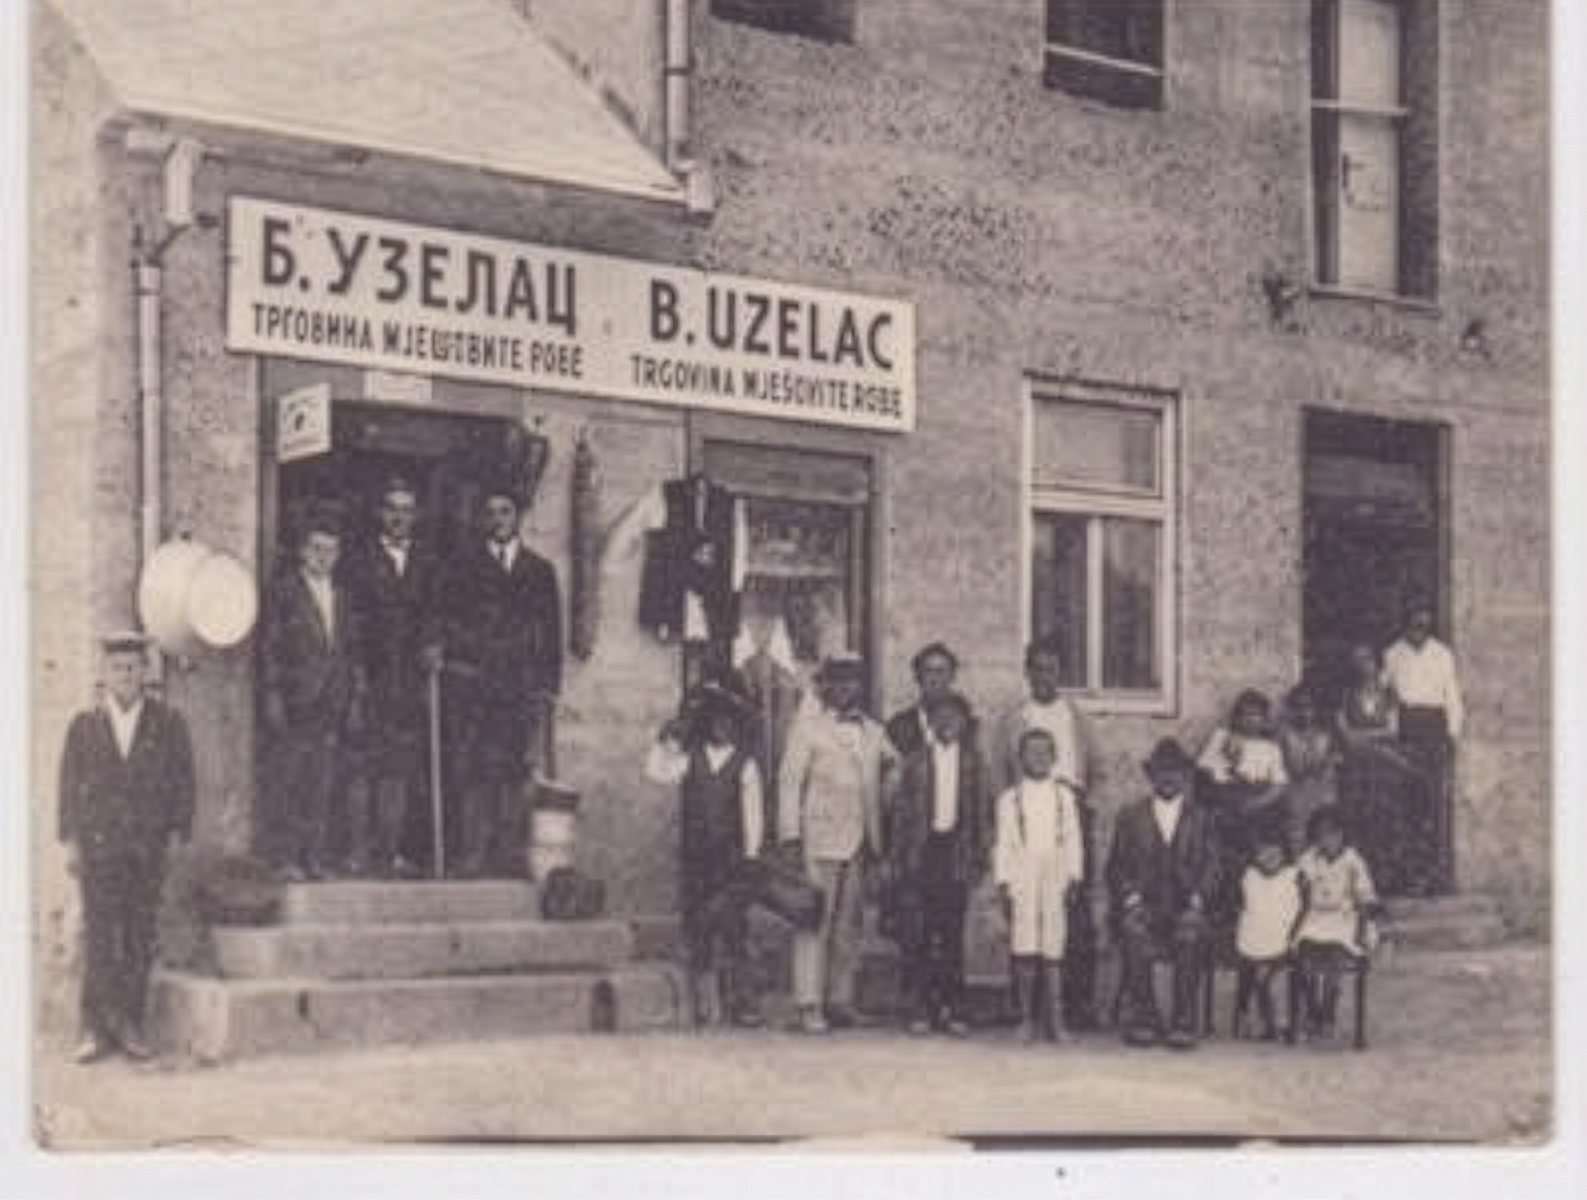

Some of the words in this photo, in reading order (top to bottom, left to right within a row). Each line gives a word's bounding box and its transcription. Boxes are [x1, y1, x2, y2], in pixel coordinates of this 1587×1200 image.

[326, 226, 577, 337] УЗЕЛАЦ
[252, 302, 375, 352] ТРГОВИНА
[707, 285, 894, 372] UZELAC
[630, 354, 737, 398] TRGOVINA
